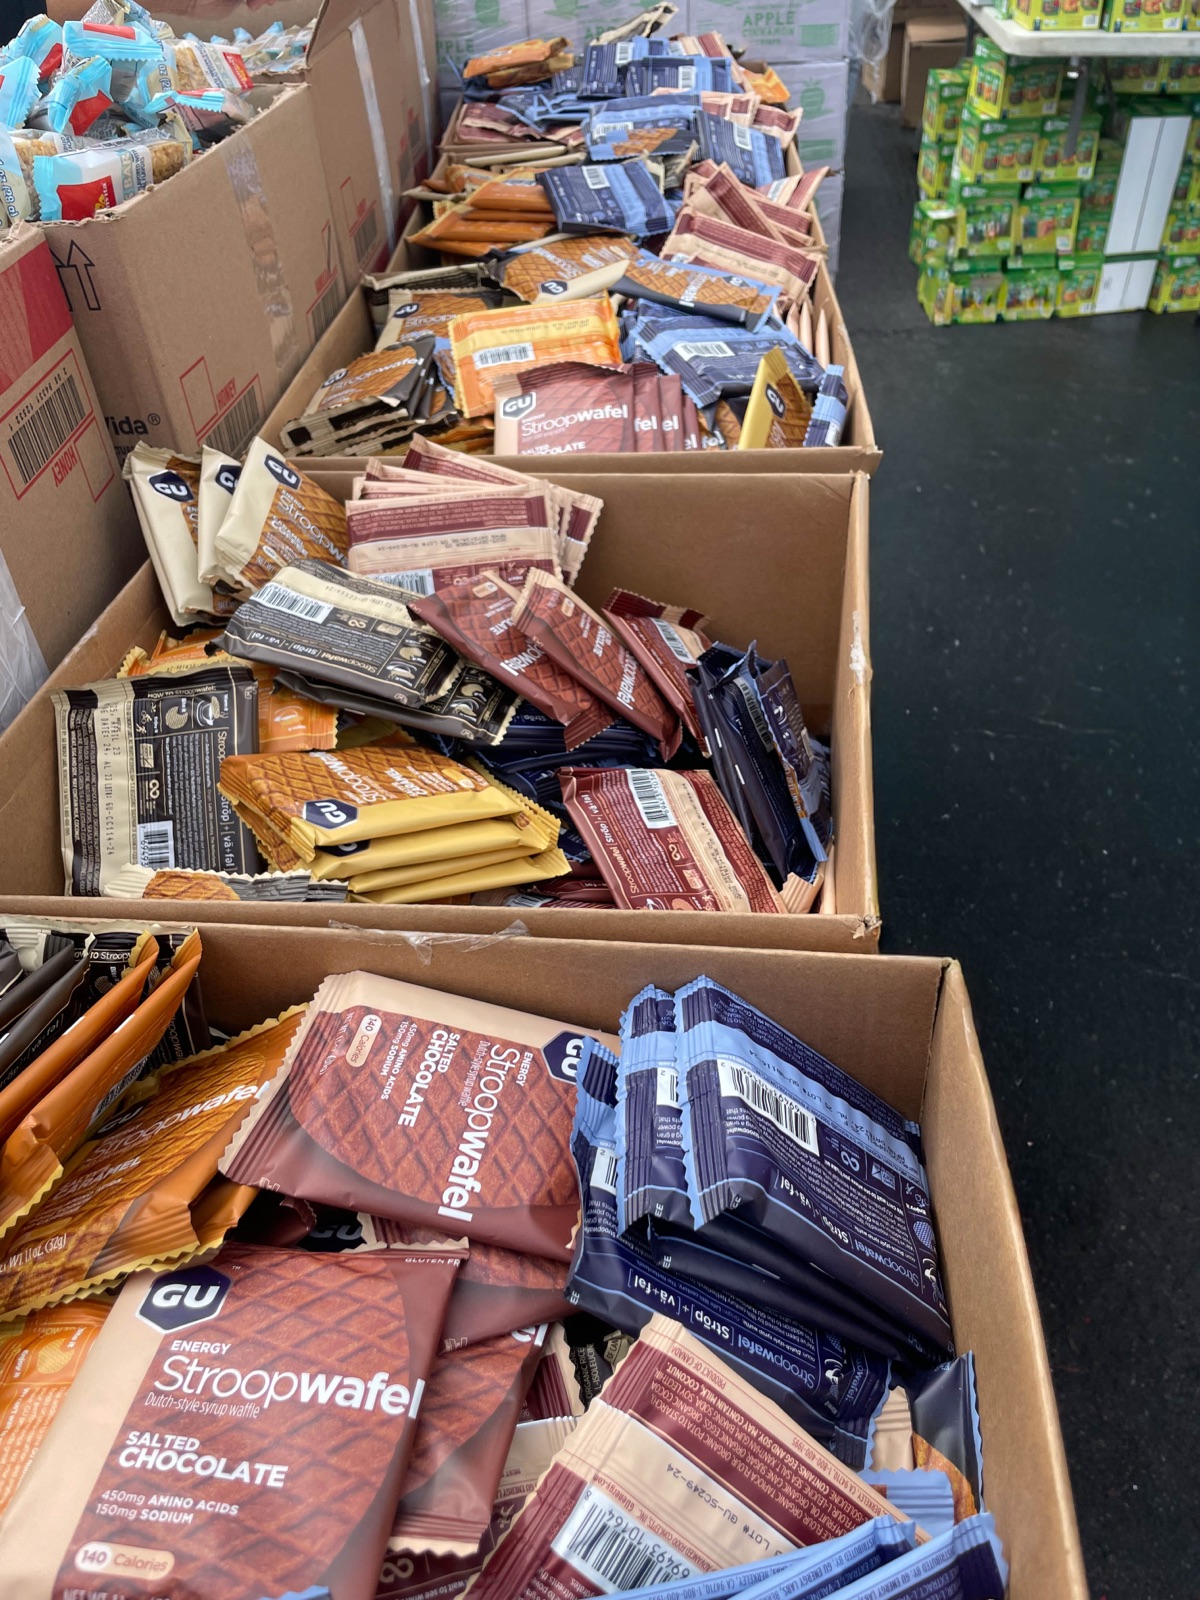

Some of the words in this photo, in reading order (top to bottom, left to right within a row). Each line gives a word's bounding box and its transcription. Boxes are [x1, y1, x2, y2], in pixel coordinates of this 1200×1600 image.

[743, 12, 796, 26] APPLE
[121, 152, 132, 187] BAR
[505, 395, 532, 412] GU
[519, 402, 630, 439] Stroopwafel
[51, 444, 78, 488] HONEY
[267, 459, 298, 485] GU
[154, 483, 188, 496] GU
[319, 650, 378, 674] Stroopwafel
[314, 801, 347, 824] GU
[609, 843, 641, 895] Stroopwafel
[363, 1016, 377, 1032] 140
[391, 1018, 408, 1045] 150mg
[400, 1021, 418, 1048] 450mg
[348, 1033, 370, 1064] Calories
[379, 1043, 398, 1076] SODIUM
[390, 1047, 407, 1074] AMINO
[435, 1031, 460, 1074] SALTED
[468, 1038, 490, 1071] Dutch-style
[396, 1027, 447, 1128] CHOCOLATE
[462, 1068, 478, 1088] syrup
[514, 1051, 533, 1086] ENERGY
[379, 1075, 395, 1100] ACIDS
[456, 1085, 473, 1108] waffle
[92, 1080, 270, 1160] Stroopwafel
[96, 1101, 146, 1138] GU
[437, 1042, 522, 1221] Stroopwafel
[851, 1237, 922, 1285] Stroopwafel
[150, 1282, 220, 1310] GU
[170, 1340, 232, 1356] ENERGY
[669, 1343, 696, 1366] CANADA
[732, 1332, 819, 1388] Stroopwafel
[663, 1360, 701, 1391] COCONUT.
[692, 1360, 703, 1371] OF
[699, 1365, 727, 1389] PRODUCT
[153, 1354, 427, 1420] Stroopwafel
[582, 1366, 592, 1398] ORGANIC
[648, 1379, 674, 1402] COCOA
[677, 1385, 695, 1402] SOY
[696, 1383, 719, 1404] MILK,
[144, 1389, 199, 1414] Dutch-style
[198, 1398, 227, 1418] syrup
[228, 1401, 261, 1420] waffle
[671, 1395, 704, 1424] ORGANIC
[691, 1394, 714, 1416] SODA,
[714, 1397, 745, 1425] CONTAIN
[676, 1413, 705, 1440] POTATO
[699, 1415, 721, 1436] EGGS,
[710, 1409, 737, 1433] BAKING
[741, 1419, 760, 1436] MAY
[124, 1427, 200, 1455] SALTED
[701, 1433, 733, 1461] ORGANIC
[717, 1429, 748, 1457] ORGANIC
[732, 1426, 752, 1445] GUM,
[754, 1430, 773, 1448] SOY.
[744, 1451, 769, 1474] SUGAR,
[747, 1439, 777, 1467] XANTHAN
[769, 1442, 787, 1459] AND
[782, 1452, 799, 1468] EGG
[789, 1436, 833, 1474] 1-800-400-1995
[117, 1444, 288, 1489] CHOCOLATE
[728, 1454, 753, 1477] FLOUR,
[764, 1468, 784, 1487] CANE
[773, 1460, 793, 1479] SALT,
[502, 1485, 524, 1494] ENERGY
[525, 1483, 533, 1491] GU
[748, 1471, 777, 1498] TAPIOCA
[788, 1473, 804, 1489] SEA
[794, 1463, 831, 1495] CONTAINS:
[829, 1468, 850, 1488] 94710,
[847, 1484, 858, 1495] CA
[100, 1486, 146, 1507] 450mg
[147, 1492, 194, 1511] AMINO
[195, 1498, 240, 1516] ACIDS
[581, 1488, 593, 1501] 8
[590, 1472, 636, 1512] GUenergy.com
[662, 1461, 741, 1524] GU-SC249-24
[781, 1481, 811, 1508] ORGANIC
[801, 1482, 834, 1511] L-LEUCINE,
[855, 1490, 883, 1516] BERKELEY,
[94, 1501, 138, 1520] 150mg
[139, 1505, 193, 1528] SODIUM
[634, 1507, 650, 1522] INC.
[773, 1491, 804, 1519] ORGANIC
[806, 1501, 822, 1517] OIL,
[829, 1505, 854, 1528] FLOUR,
[602, 1507, 647, 1545] 10164
[644, 1514, 676, 1542] CONCEPTS,
[800, 1512, 824, 1535] FLOUR,
[818, 1511, 838, 1530] FRUIT
[670, 1535, 688, 1551] FOOD
[740, 1521, 771, 1550] LOT#
[79, 1547, 107, 1565] 140
[112, 1551, 168, 1574] Calories
[647, 1541, 692, 1581] 69493
[683, 1545, 714, 1571] ADVANCED
[822, 1560, 833, 1574] GU
[831, 1555, 844, 1568] BY:
[725, 1578, 736, 1588] CA
[735, 1570, 770, 1586] BERKELEY,
[799, 1567, 823, 1588] ENERGY
[899, 1571, 911, 1584] GU
[908, 1565, 922, 1579] BY:
[425, 1588, 438, 1598] see
[438, 1585, 447, 1594] to
[447, 1579, 464, 1591] wait
[701, 1580, 725, 1593] 94710,
[779, 1580, 799, 1598] LABS,
[875, 1576, 901, 1597] ENERGY
